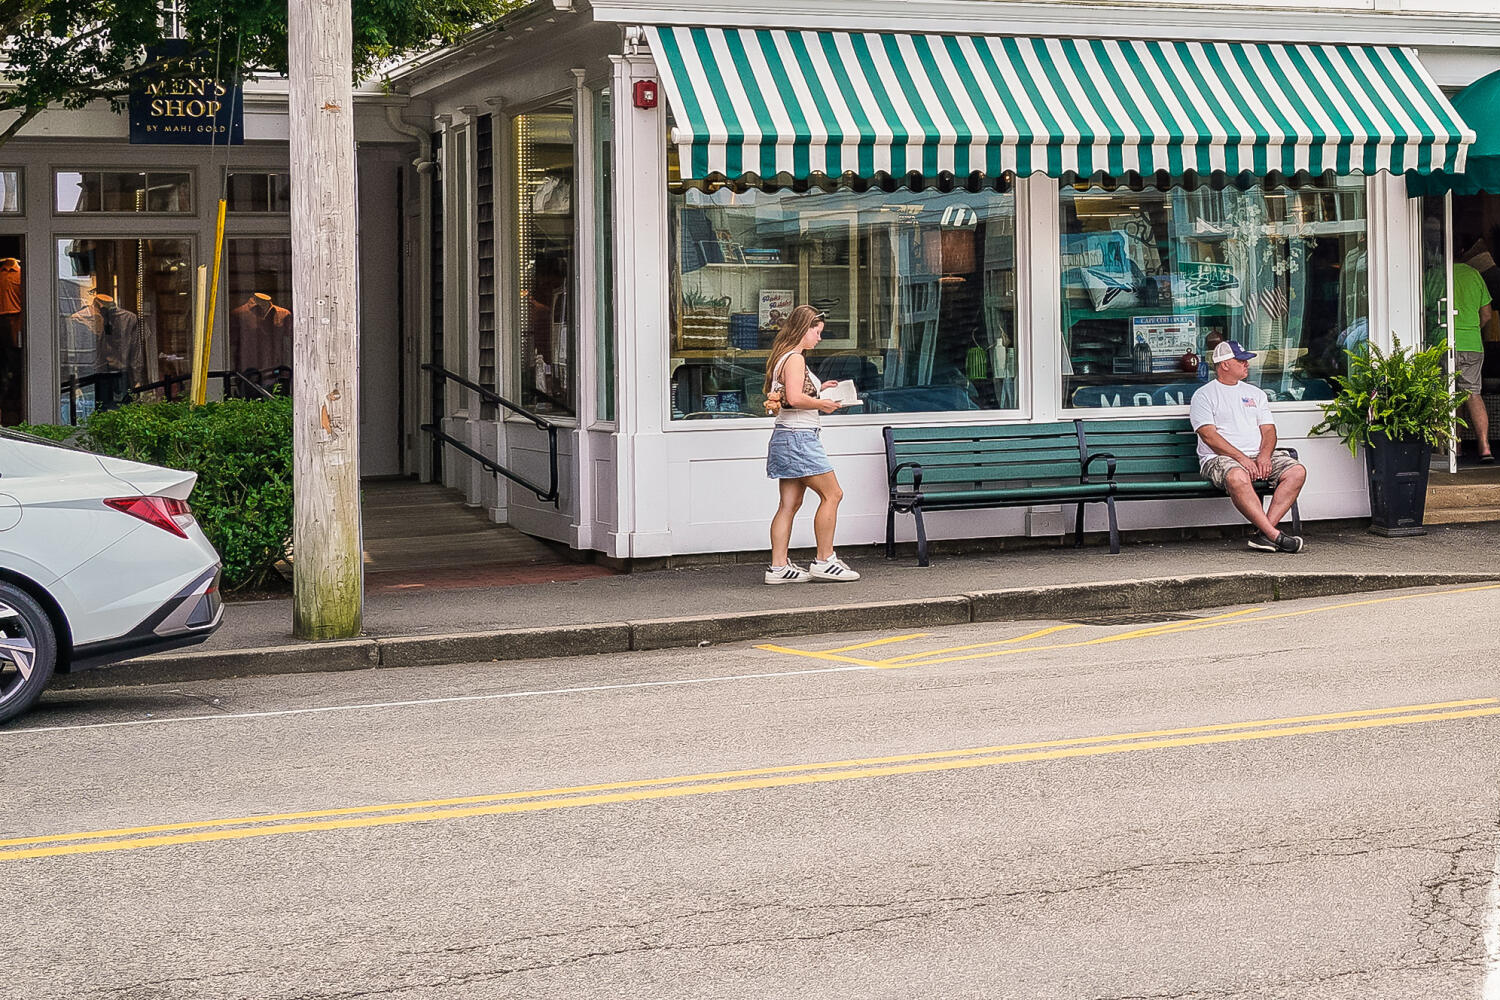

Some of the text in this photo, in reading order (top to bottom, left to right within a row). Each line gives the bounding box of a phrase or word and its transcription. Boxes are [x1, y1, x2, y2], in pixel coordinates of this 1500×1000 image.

[144, 79, 227, 96] MEN'S
[150, 99, 222, 118] SHOP
[197, 125, 226, 133] GOLD
